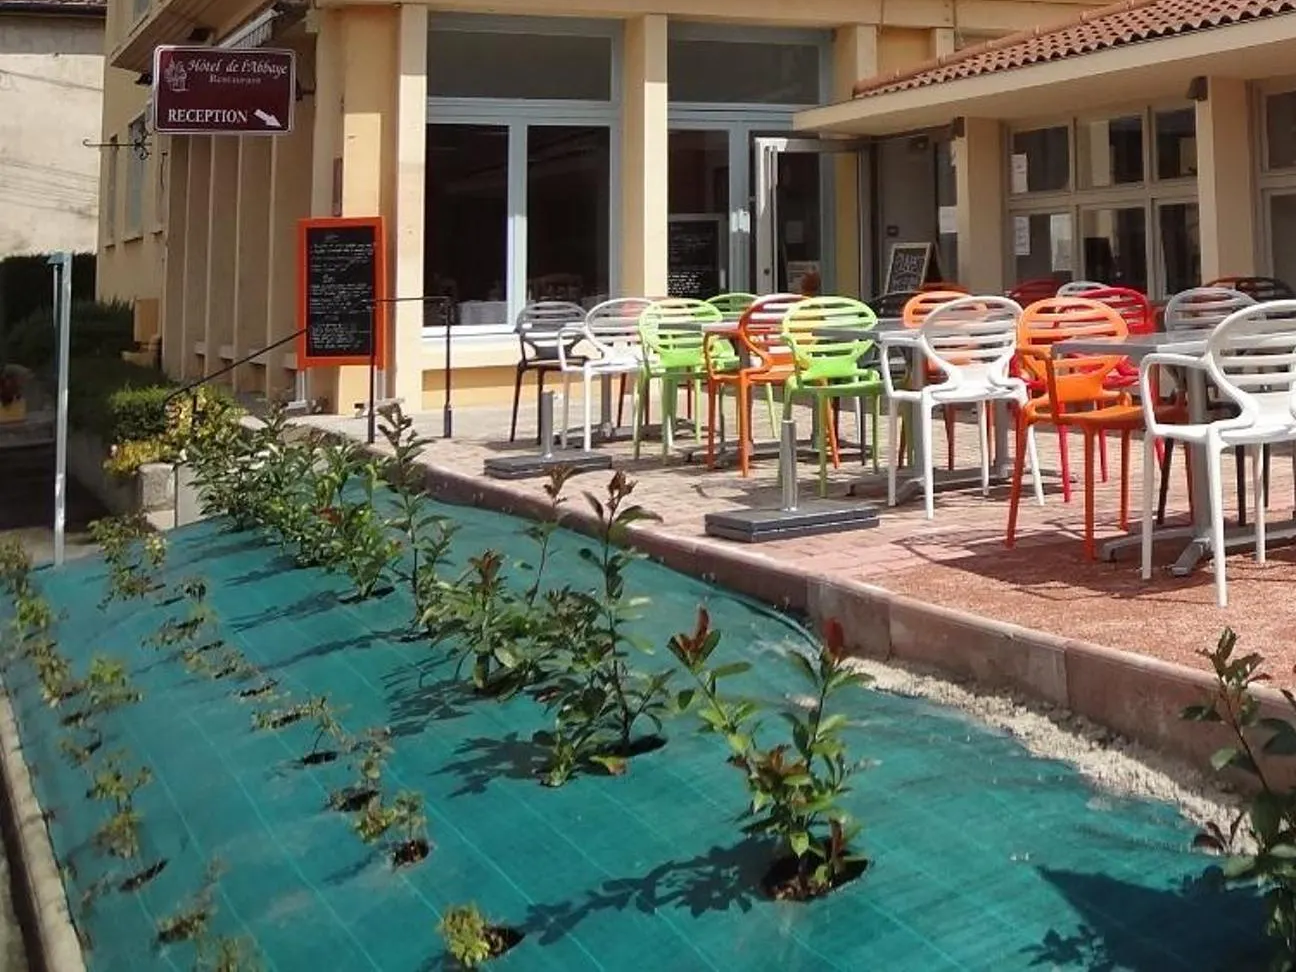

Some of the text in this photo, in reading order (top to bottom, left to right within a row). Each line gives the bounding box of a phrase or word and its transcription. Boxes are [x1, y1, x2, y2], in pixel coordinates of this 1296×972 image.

[188, 59, 222, 72] Hôtel
[226, 59, 240, 73] de
[168, 109, 248, 124] RECEPTION
